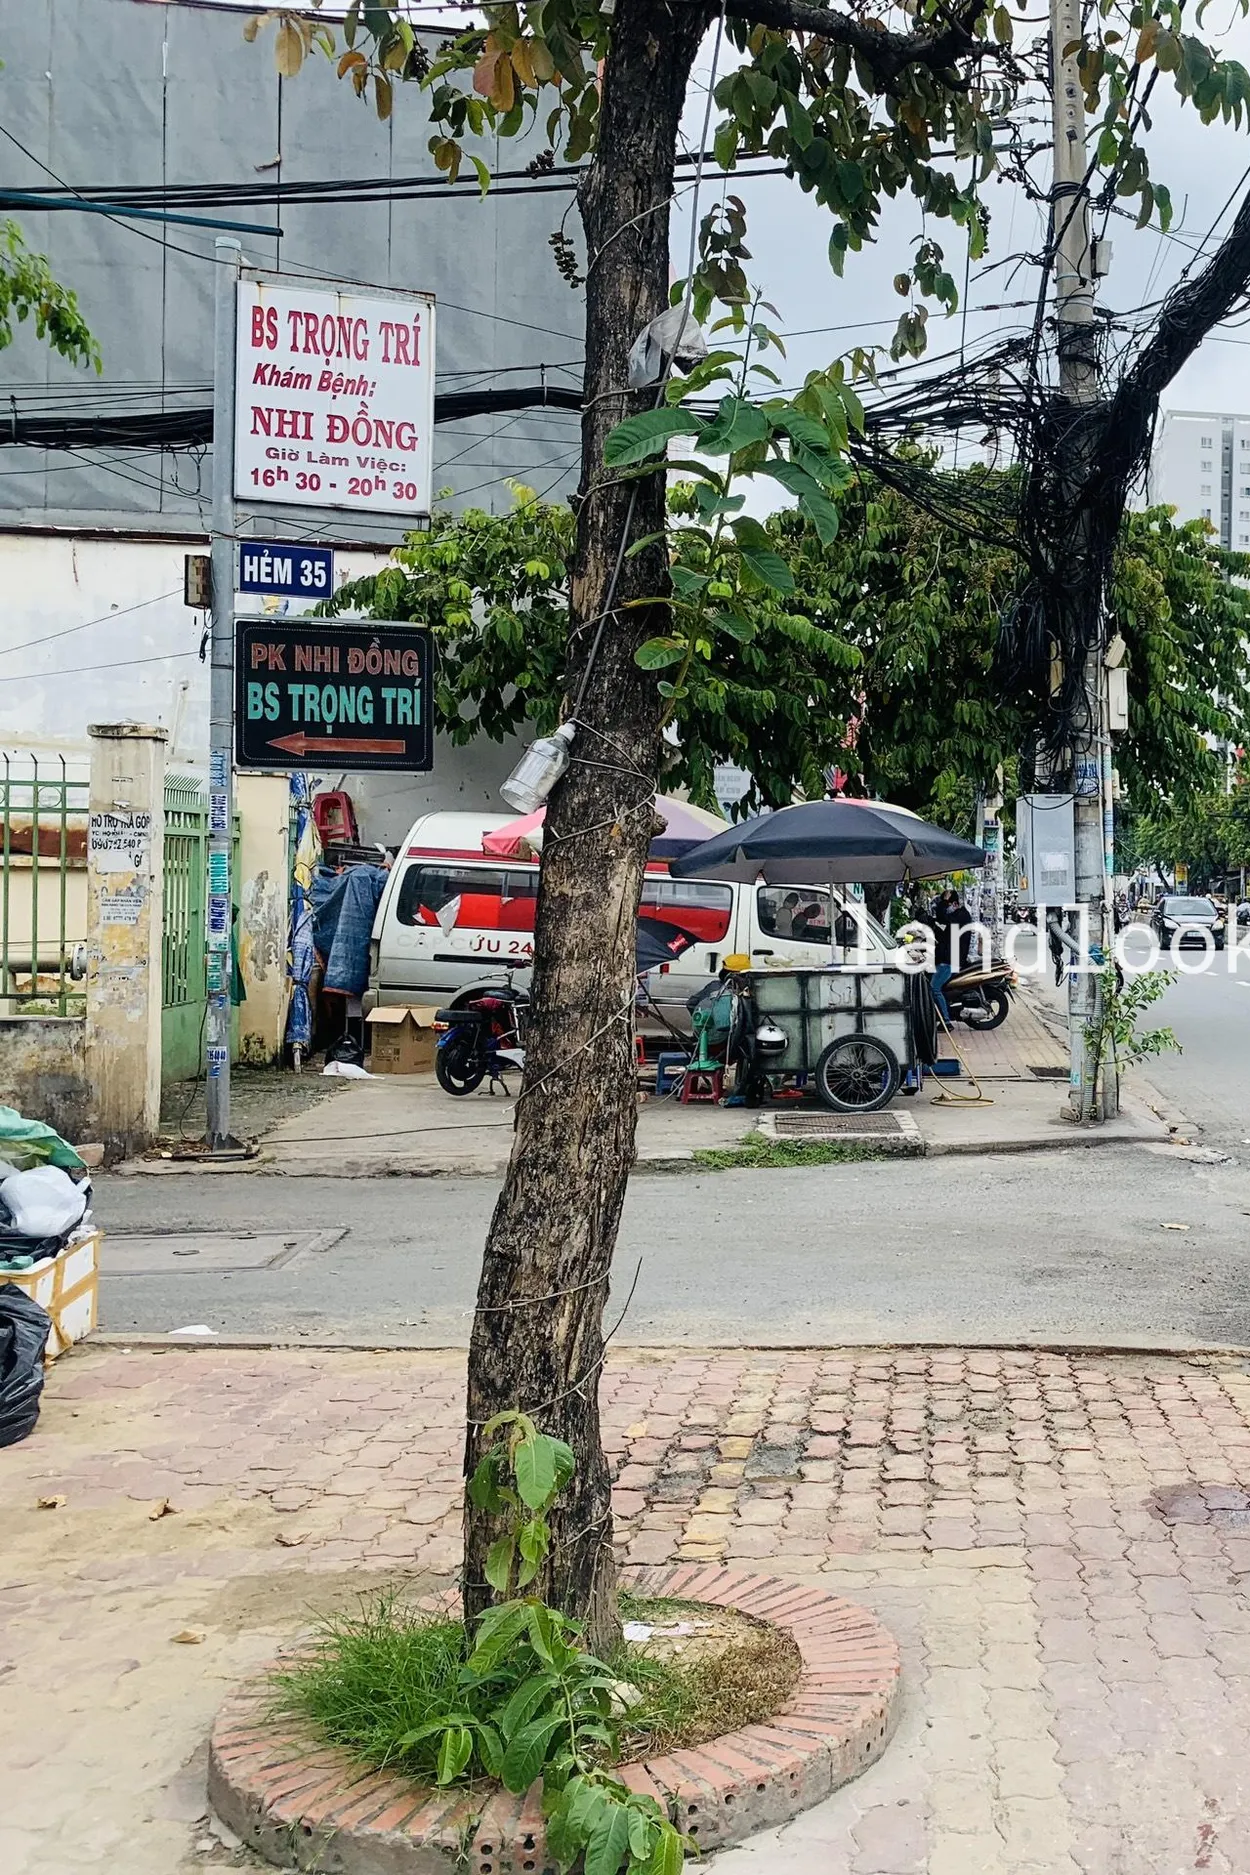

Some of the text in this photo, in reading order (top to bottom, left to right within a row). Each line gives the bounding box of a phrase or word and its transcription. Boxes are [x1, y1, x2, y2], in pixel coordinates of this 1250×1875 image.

[251, 305, 421, 366] BS TRỌNG TRÍ
[252, 362, 377, 400] Khám Bệnh:
[250, 400, 419, 452] NHI ĐỒNG
[265, 446, 406, 474] Giờ Làm Việc:
[295, 472, 321, 491] 30
[392, 481, 418, 500] 30
[243, 549, 327, 588] HẺM 35
[251, 637, 420, 676] PK NHI ĐỒNG
[247, 678, 422, 734] BS TRỌNG TRÍ
